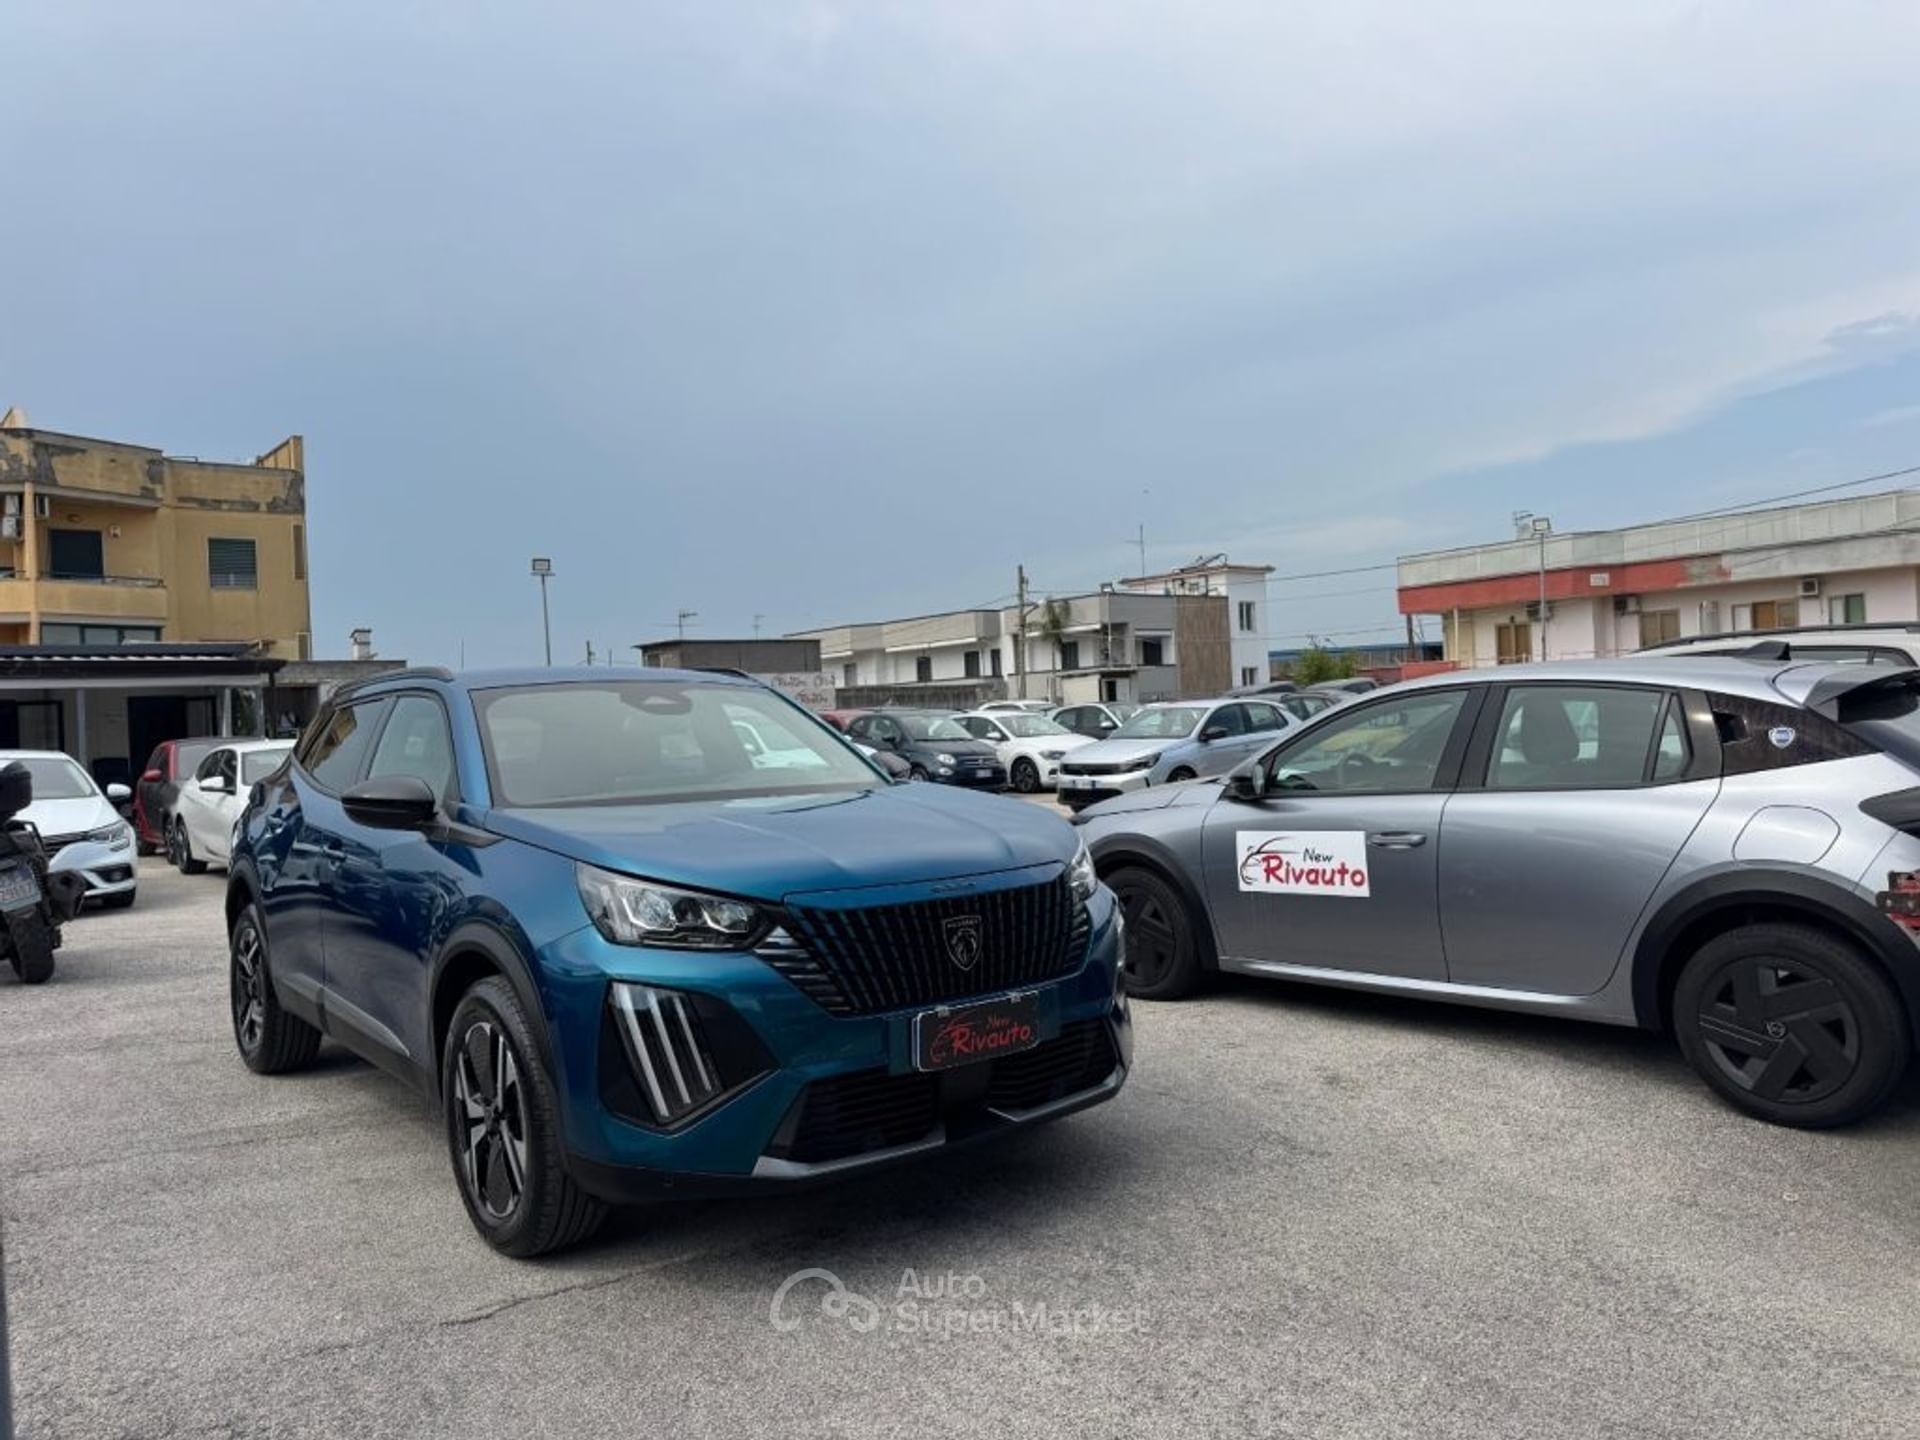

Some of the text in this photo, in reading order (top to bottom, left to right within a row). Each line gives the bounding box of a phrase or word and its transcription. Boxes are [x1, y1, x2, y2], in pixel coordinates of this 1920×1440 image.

[1261, 854, 1366, 887] Rivauto
[1303, 847, 1334, 863] New
[950, 1023, 1032, 1057] Rivauto
